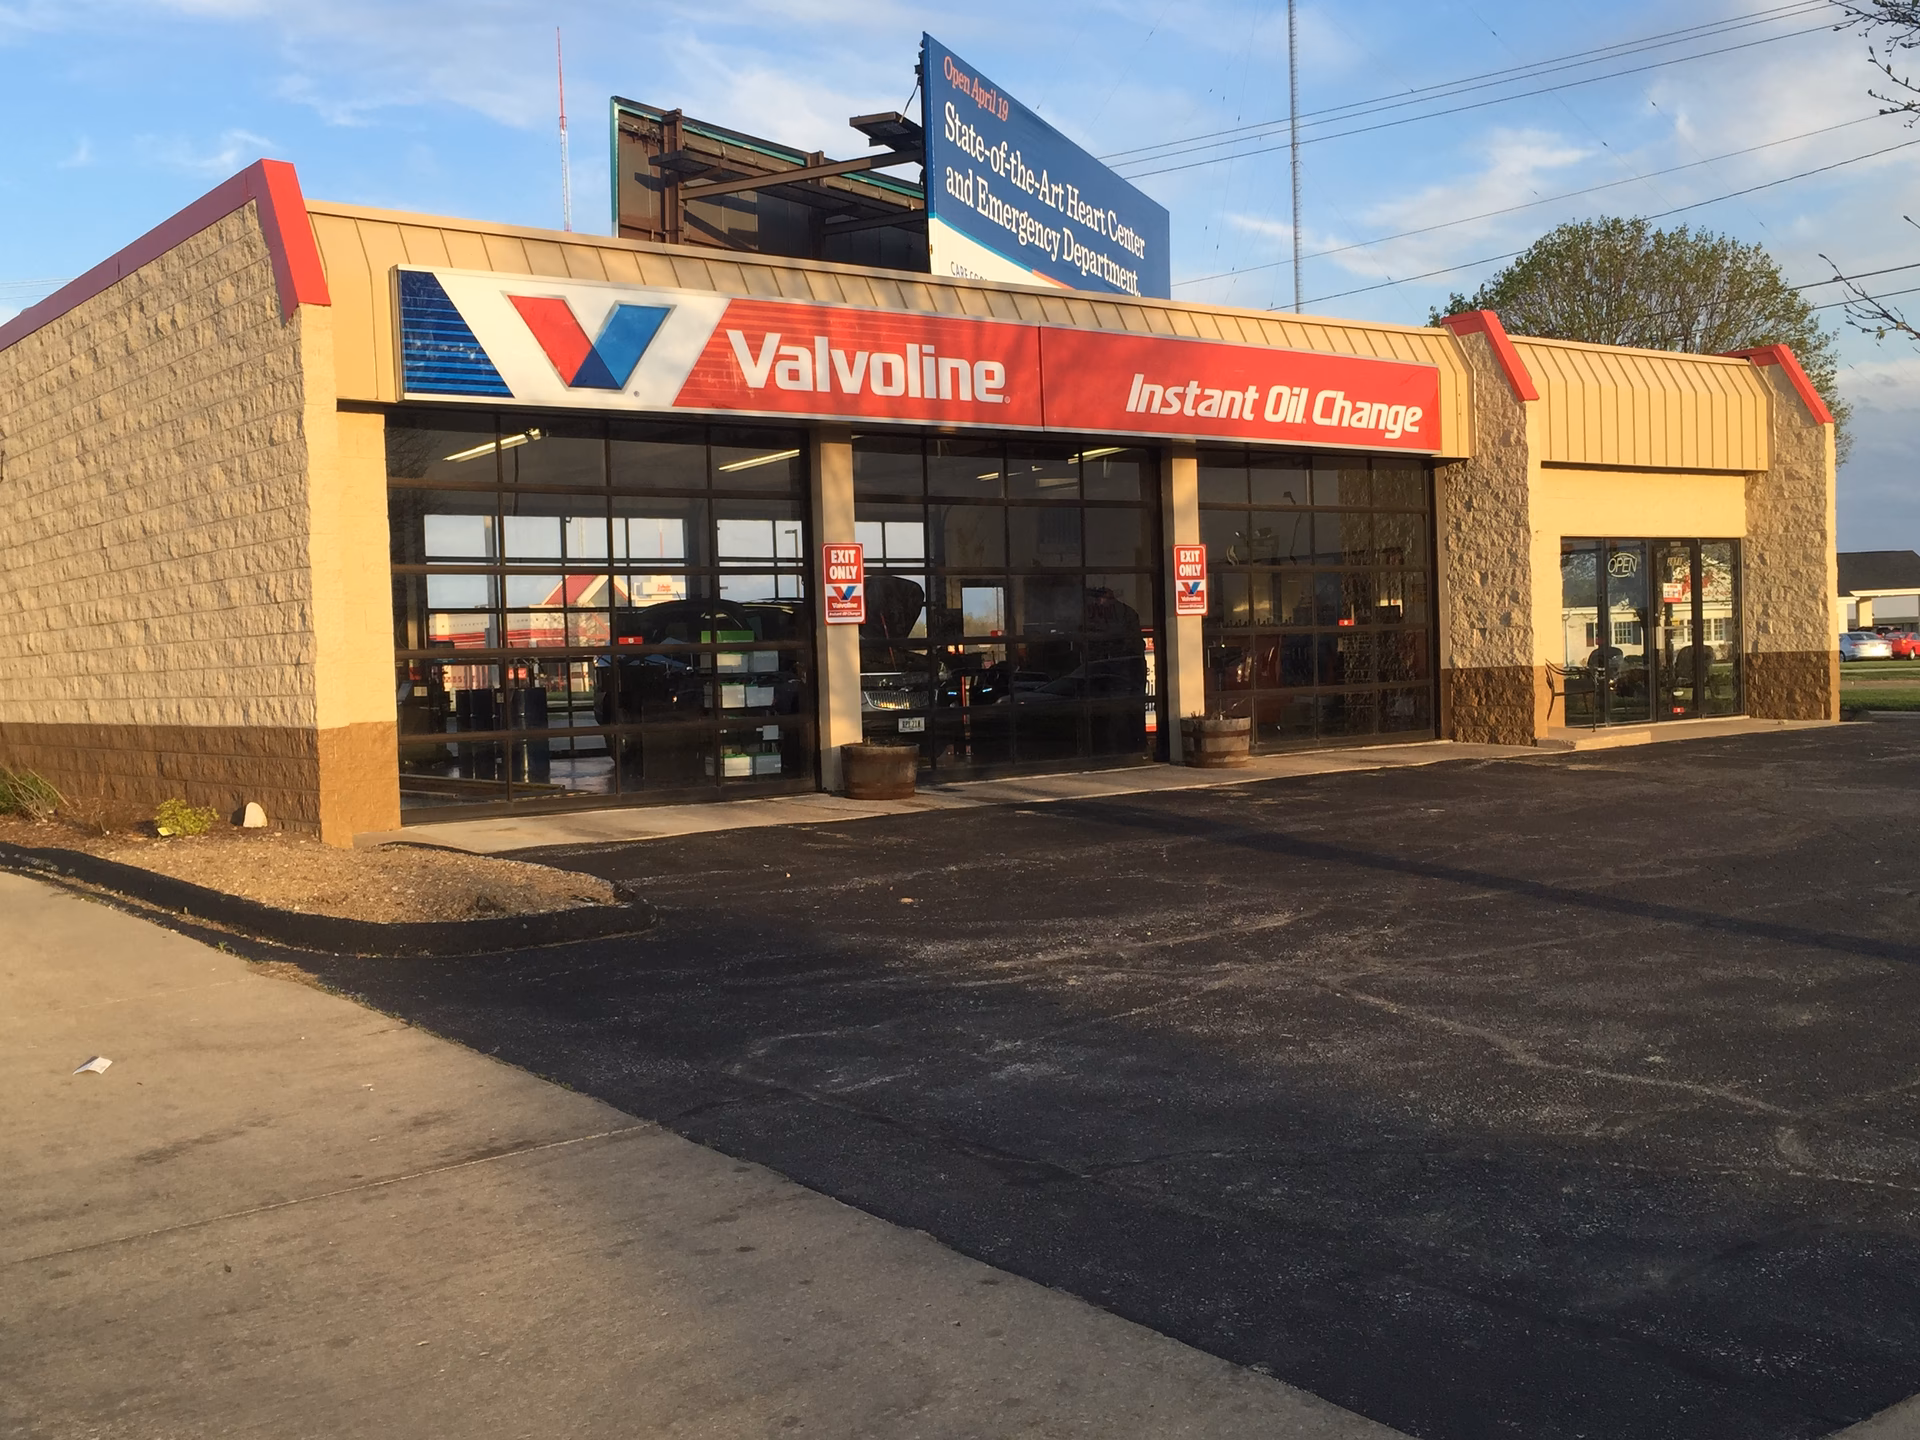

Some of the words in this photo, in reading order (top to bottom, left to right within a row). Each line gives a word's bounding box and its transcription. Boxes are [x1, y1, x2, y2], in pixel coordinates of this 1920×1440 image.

[943, 55, 970, 93] Open
[971, 77, 996, 115] April
[998, 99, 1009, 122] 19
[944, 101, 1064, 213] State-of-the-Art
[1066, 183, 1107, 236] Heart
[1107, 209, 1145, 260] Center
[946, 166, 973, 209] and
[976, 176, 1061, 262] Emergency
[726, 328, 1006, 403] Valvoline
[1125, 373, 1260, 421] Instant
[1263, 385, 1310, 424] Oil
[1311, 389, 1423, 440] Change
[829, 565, 858, 580] ONLY
[830, 549, 856, 564] EXIT
[1179, 564, 1202, 577] ONLY
[1180, 549, 1200, 563] EXIT
[1607, 557, 1637, 574] OPEN
